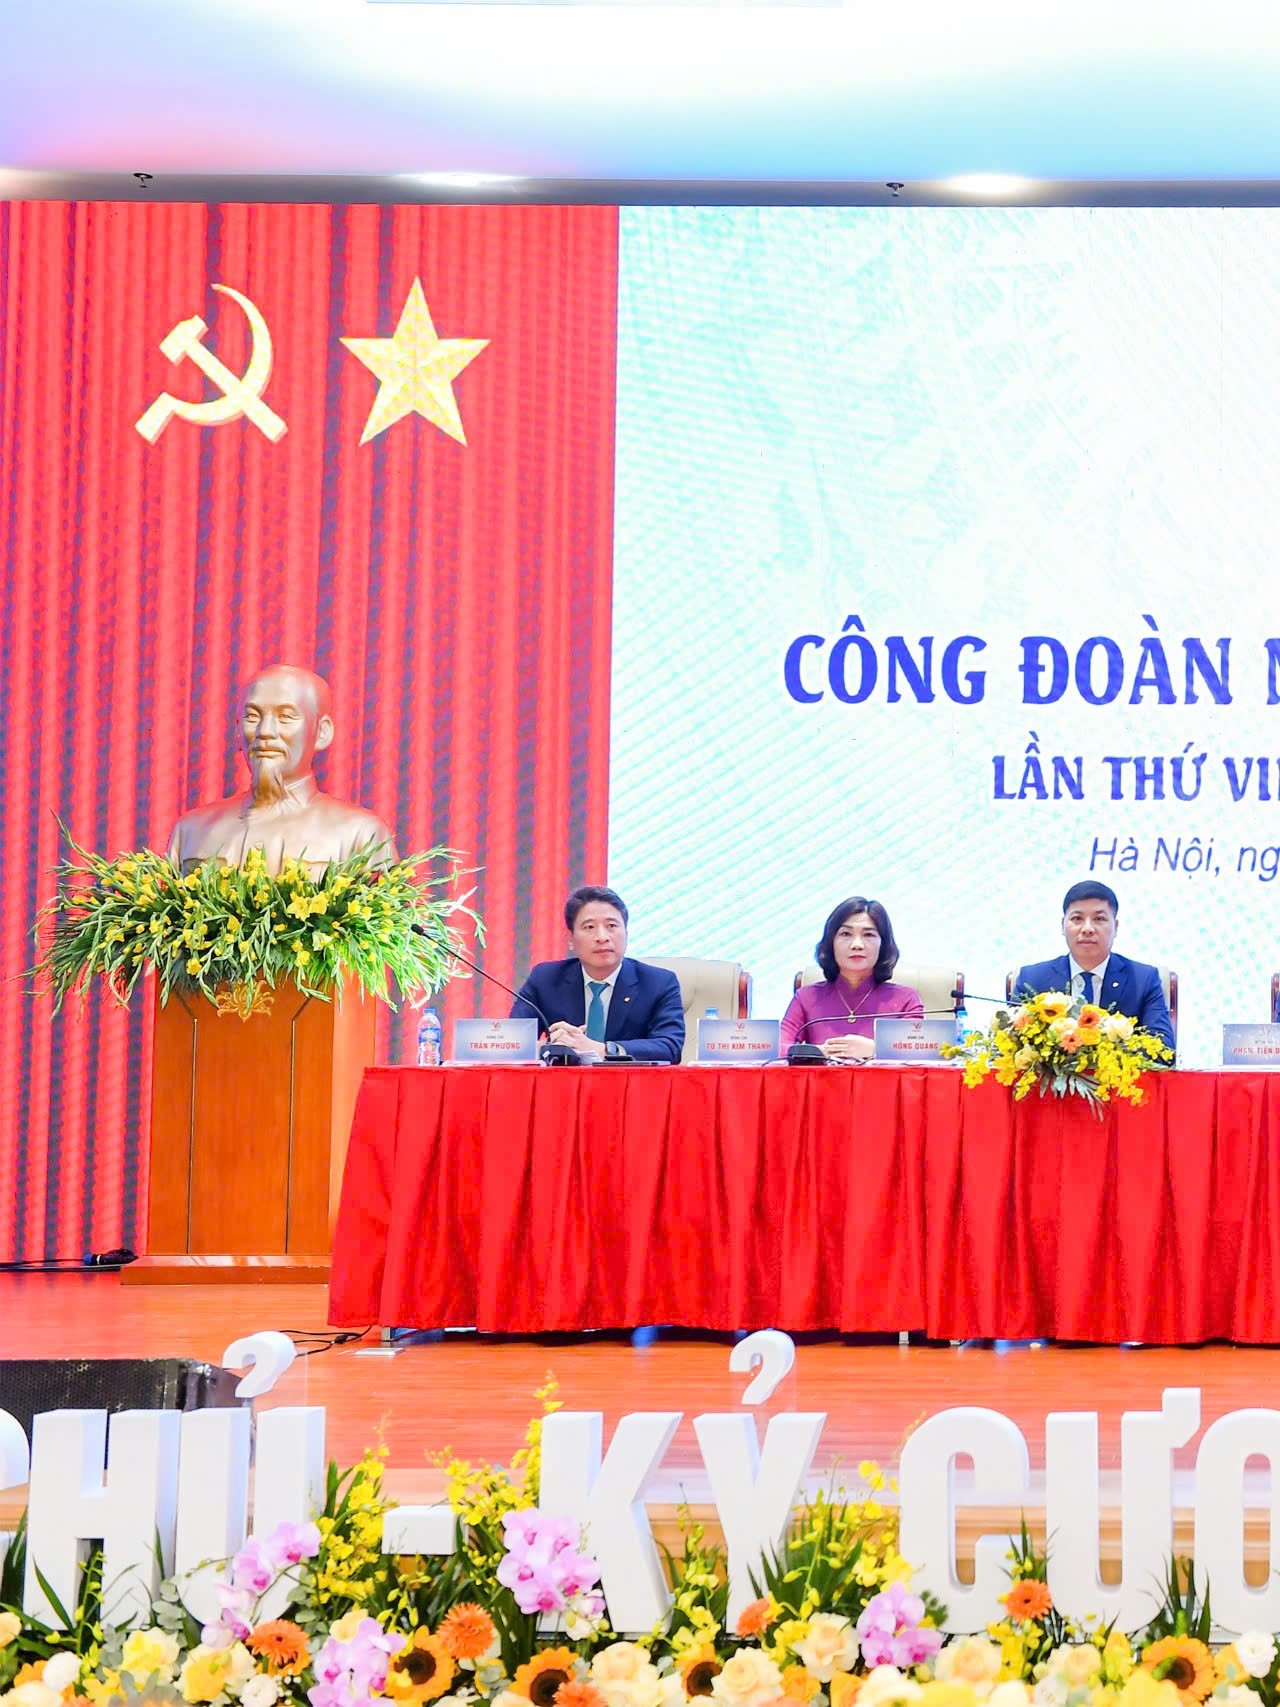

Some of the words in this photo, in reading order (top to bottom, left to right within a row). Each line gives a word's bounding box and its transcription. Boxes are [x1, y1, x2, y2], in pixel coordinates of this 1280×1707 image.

[784, 615, 987, 704] CÔNG
[1019, 614, 1232, 705] ĐOÀN
[992, 731, 1084, 800] LẦN
[1103, 742, 1207, 800] THỨ
[1090, 837, 1138, 871] Hà
[1155, 837, 1219, 879] Nội,
[0, 1331, 326, 1632] HỦ
